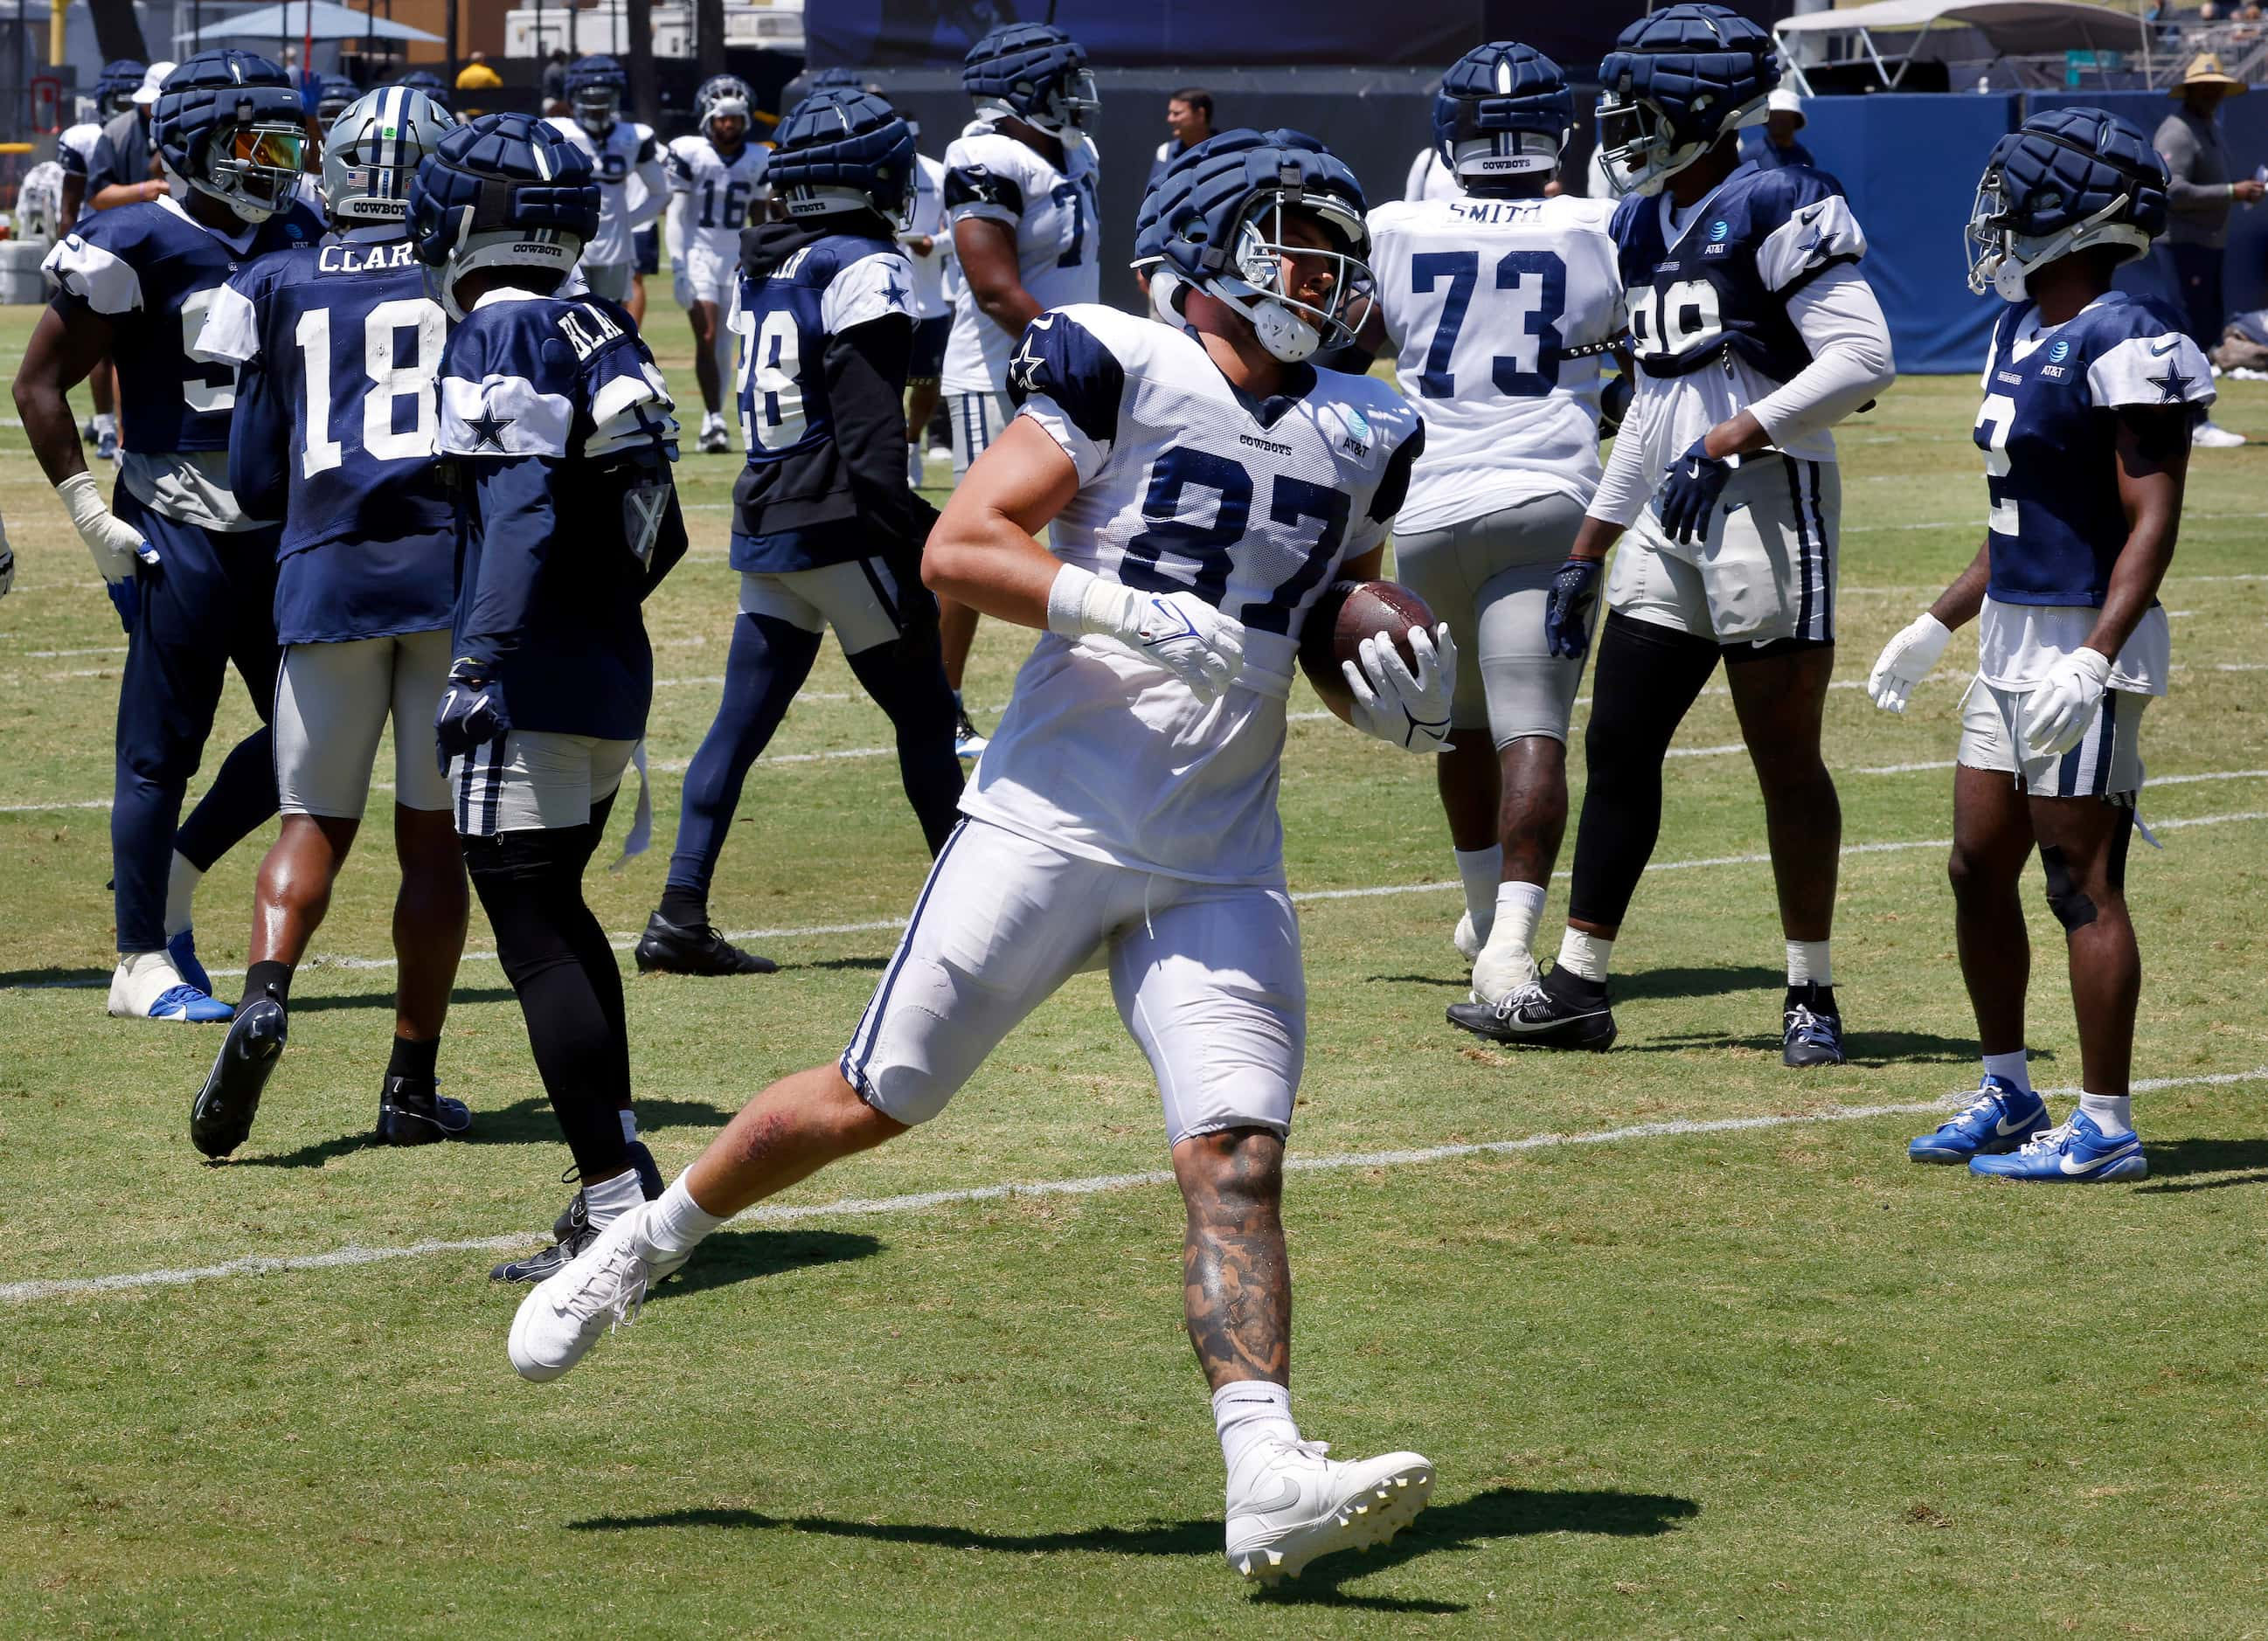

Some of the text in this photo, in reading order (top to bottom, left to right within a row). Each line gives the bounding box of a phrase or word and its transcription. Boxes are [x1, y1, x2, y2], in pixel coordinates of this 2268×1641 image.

[1482, 159, 1531, 170] COWBOYS
[699, 179, 752, 229] 16
[1447, 203, 1543, 224] SMITH
[319, 241, 421, 273] CLAR
[513, 244, 563, 257] COWBOYS
[1704, 242, 1727, 255] AT&T
[557, 302, 625, 362] BLA
[1411, 250, 1567, 399] 73
[2041, 364, 2065, 378] AT&T
[295, 297, 447, 480] 18
[1239, 433, 1293, 456] COWBOYS
[1342, 436, 1370, 459] AT&T
[1118, 446, 1352, 637] 87
